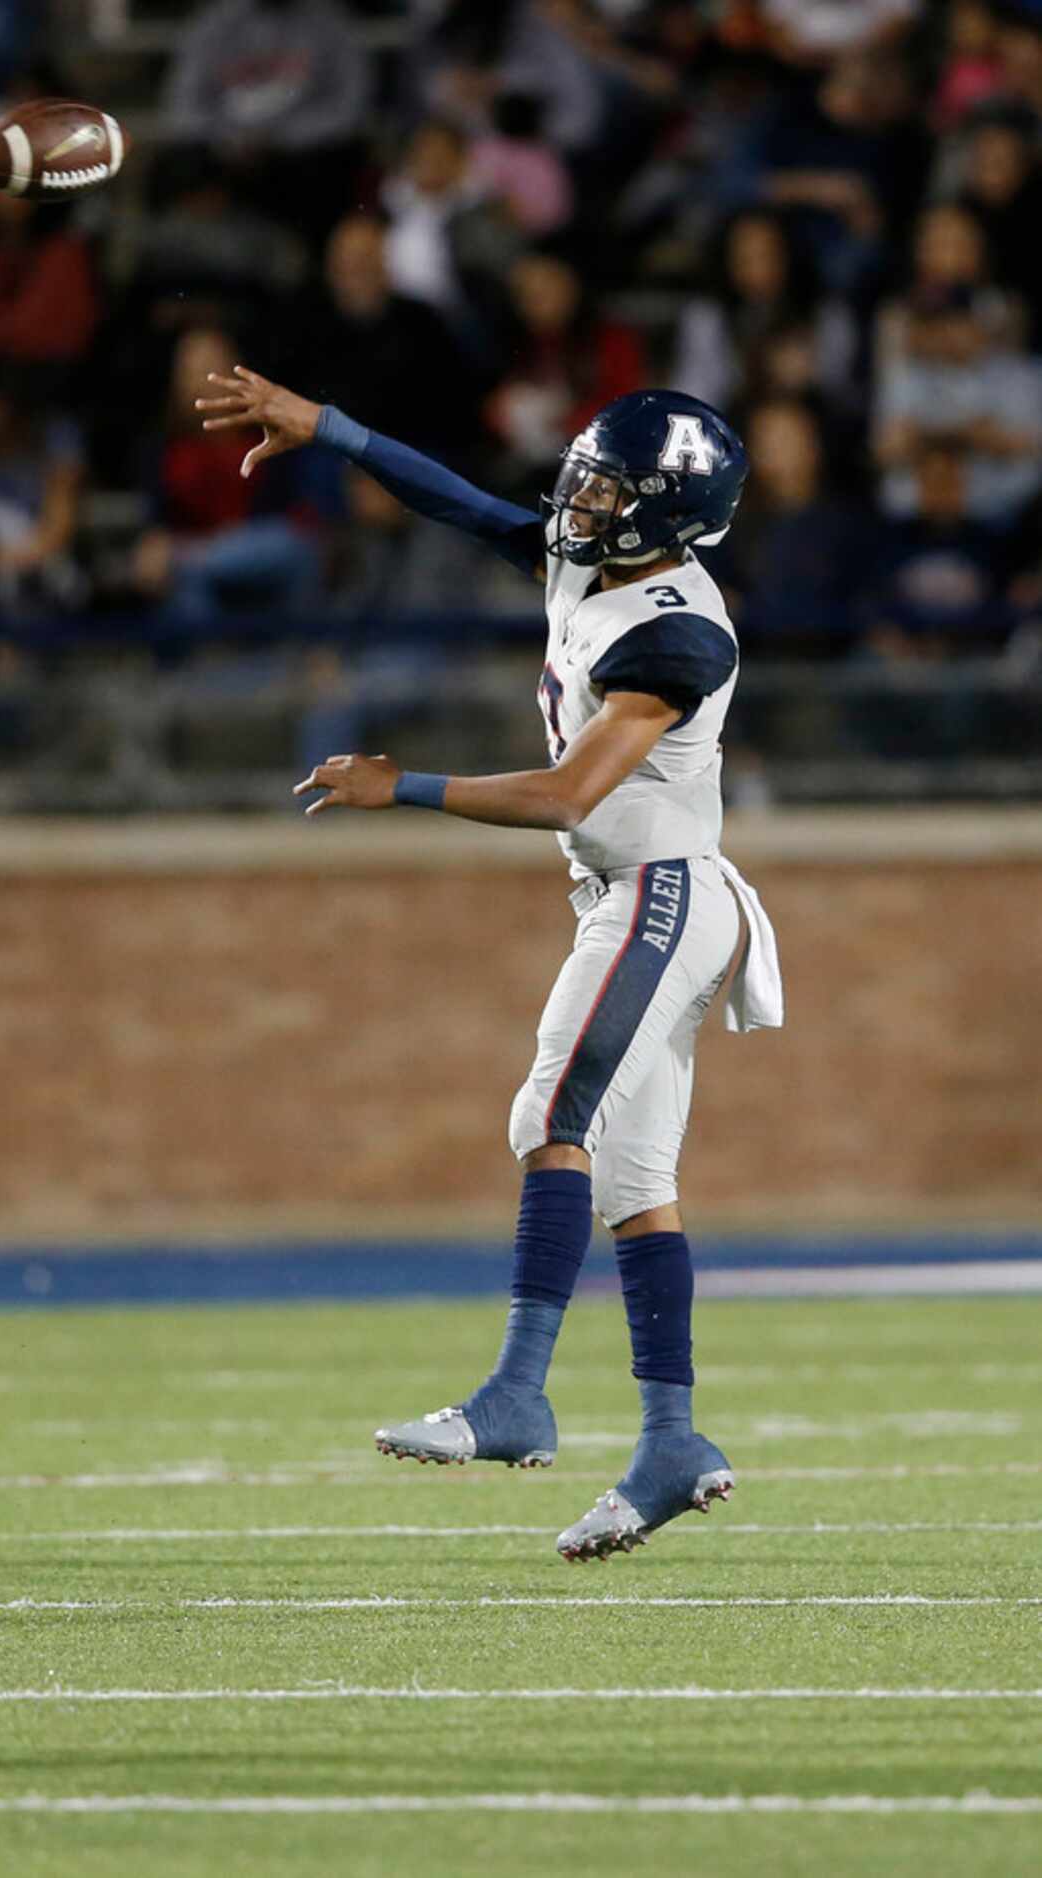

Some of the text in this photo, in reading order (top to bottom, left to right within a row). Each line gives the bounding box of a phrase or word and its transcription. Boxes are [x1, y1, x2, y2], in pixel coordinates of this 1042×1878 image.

[659, 414, 712, 476] A
[645, 585, 688, 608] 3
[642, 866, 682, 953] ALLEN
